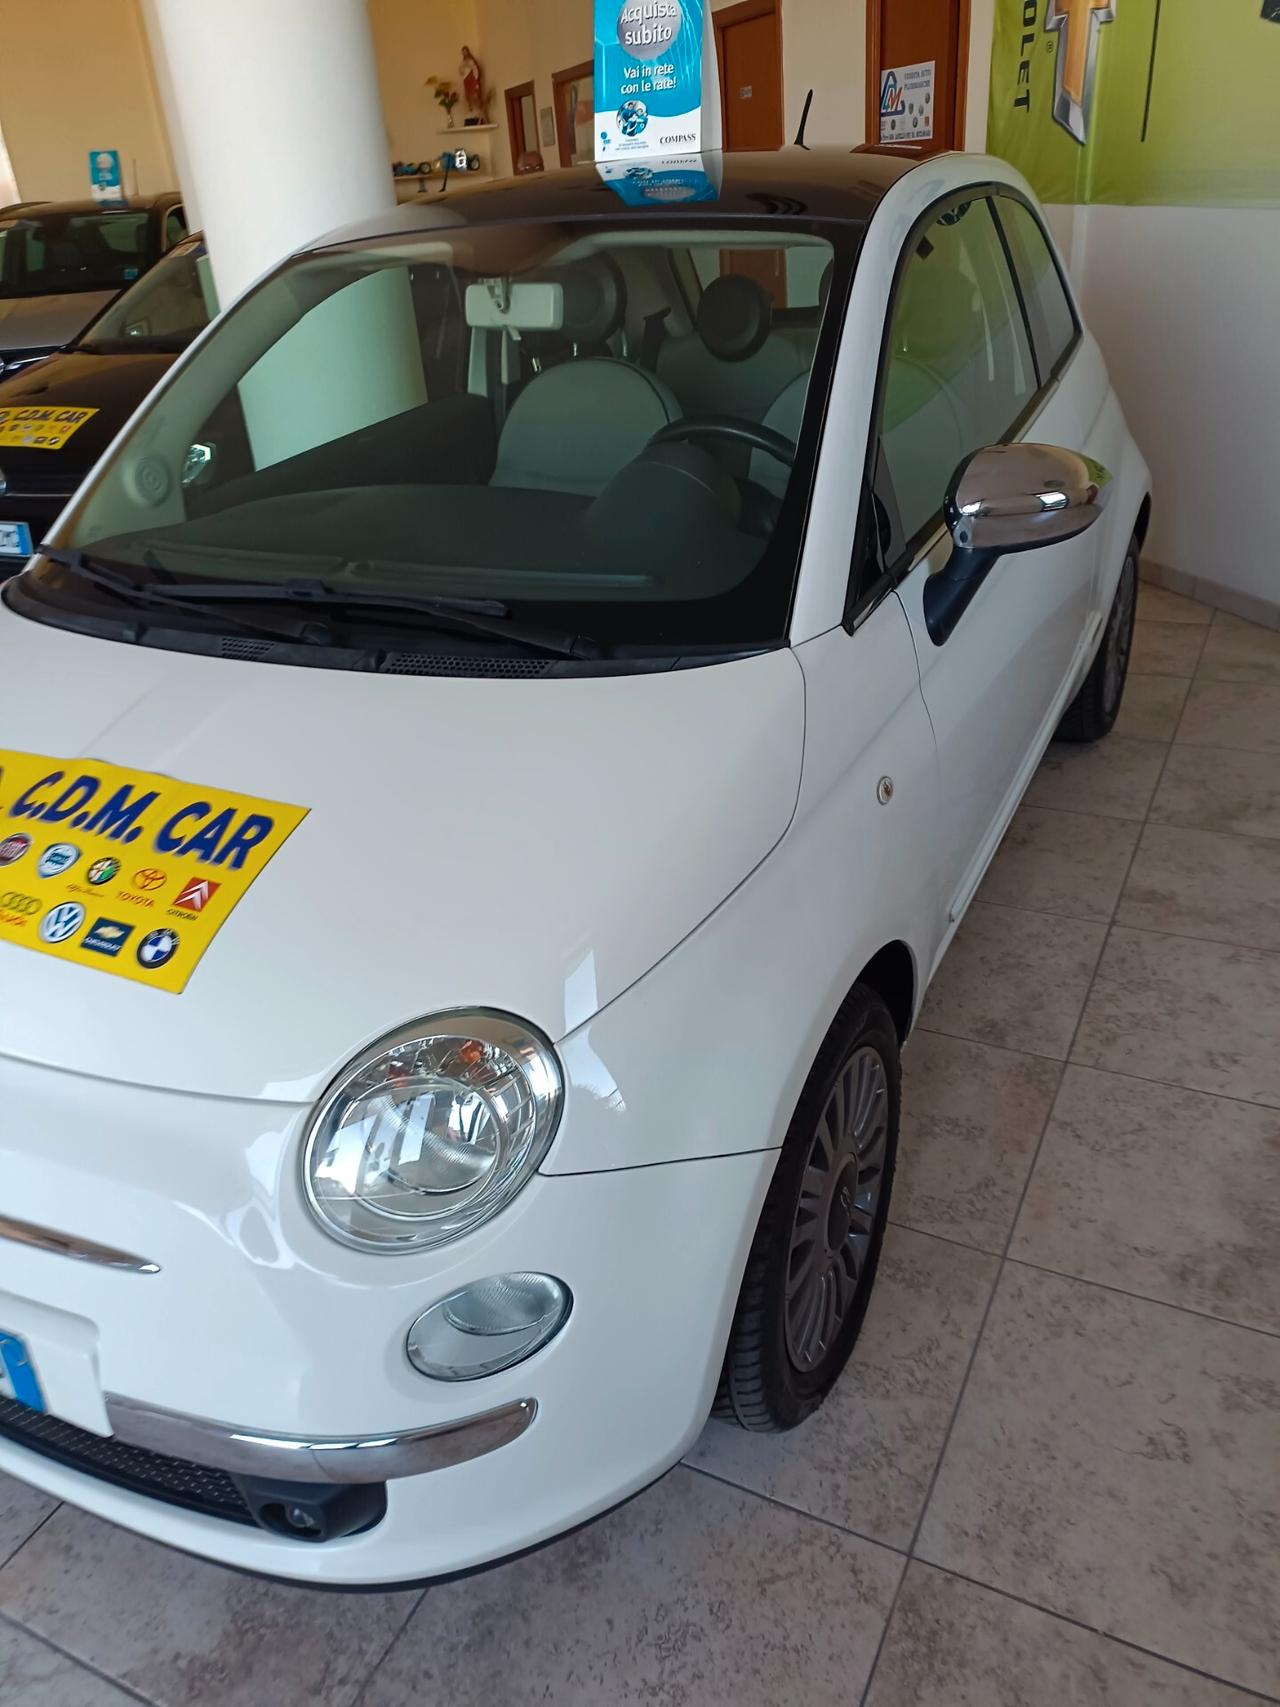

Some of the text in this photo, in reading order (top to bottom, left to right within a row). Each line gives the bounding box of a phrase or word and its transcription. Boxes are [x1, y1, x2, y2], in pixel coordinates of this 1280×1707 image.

[620, 1, 678, 26] Acquista
[625, 23, 673, 46] subito
[623, 63, 674, 79] Vai in rete
[620, 76, 677, 95] con le rate!
[659, 133, 697, 145] COMPASS
[54, 410, 89, 423] CAR
[8, 770, 162, 845] C.D.M.
[153, 800, 275, 872] CAR
